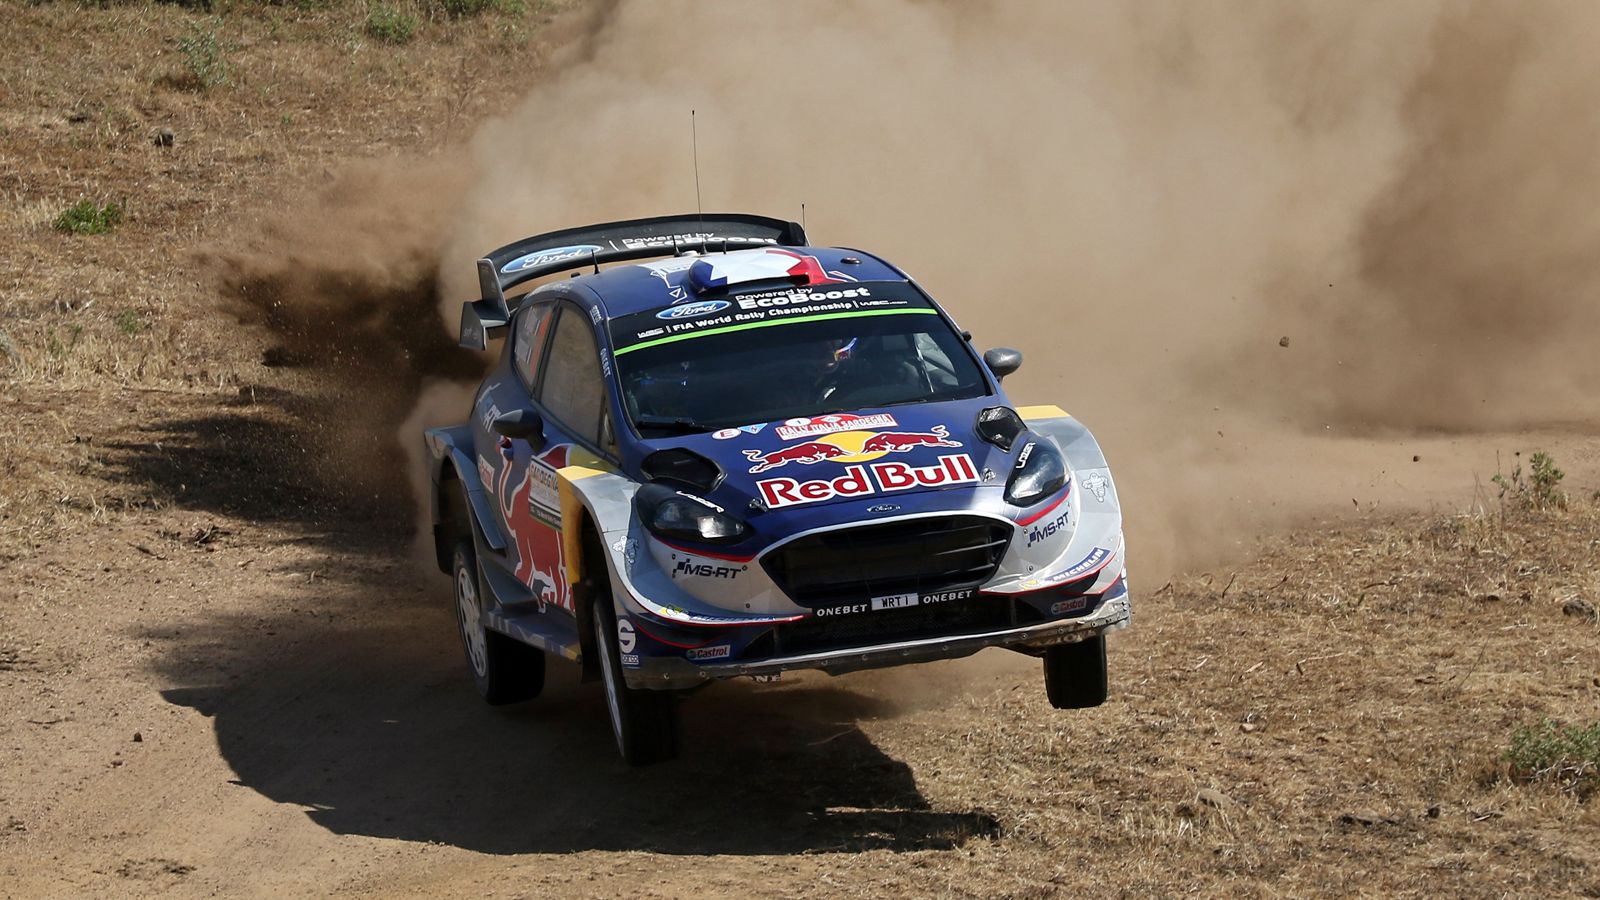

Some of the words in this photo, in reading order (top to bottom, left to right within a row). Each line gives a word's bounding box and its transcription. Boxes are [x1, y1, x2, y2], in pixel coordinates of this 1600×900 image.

[622, 233, 691, 243] Powered
[625, 236, 778, 249] EcoBoost
[735, 288, 794, 301] Powered
[738, 287, 871, 309] EcoBoost
[672, 321, 695, 333] FIA
[695, 316, 732, 328] World
[735, 311, 765, 321] Rally
[769, 301, 852, 316] Championship
[780, 424, 811, 437] RALLY
[811, 421, 841, 433] ITALIA
[841, 413, 889, 427] SARDEGNA
[719, 430, 734, 438] E
[758, 465, 873, 508] Red
[871, 454, 979, 491] Bull
[1052, 548, 1105, 581] MICHELIN
[881, 597, 901, 608] WRT
[923, 590, 973, 604] ONEBET
[816, 603, 868, 617] ONEBET
[697, 646, 729, 658] Castrol
